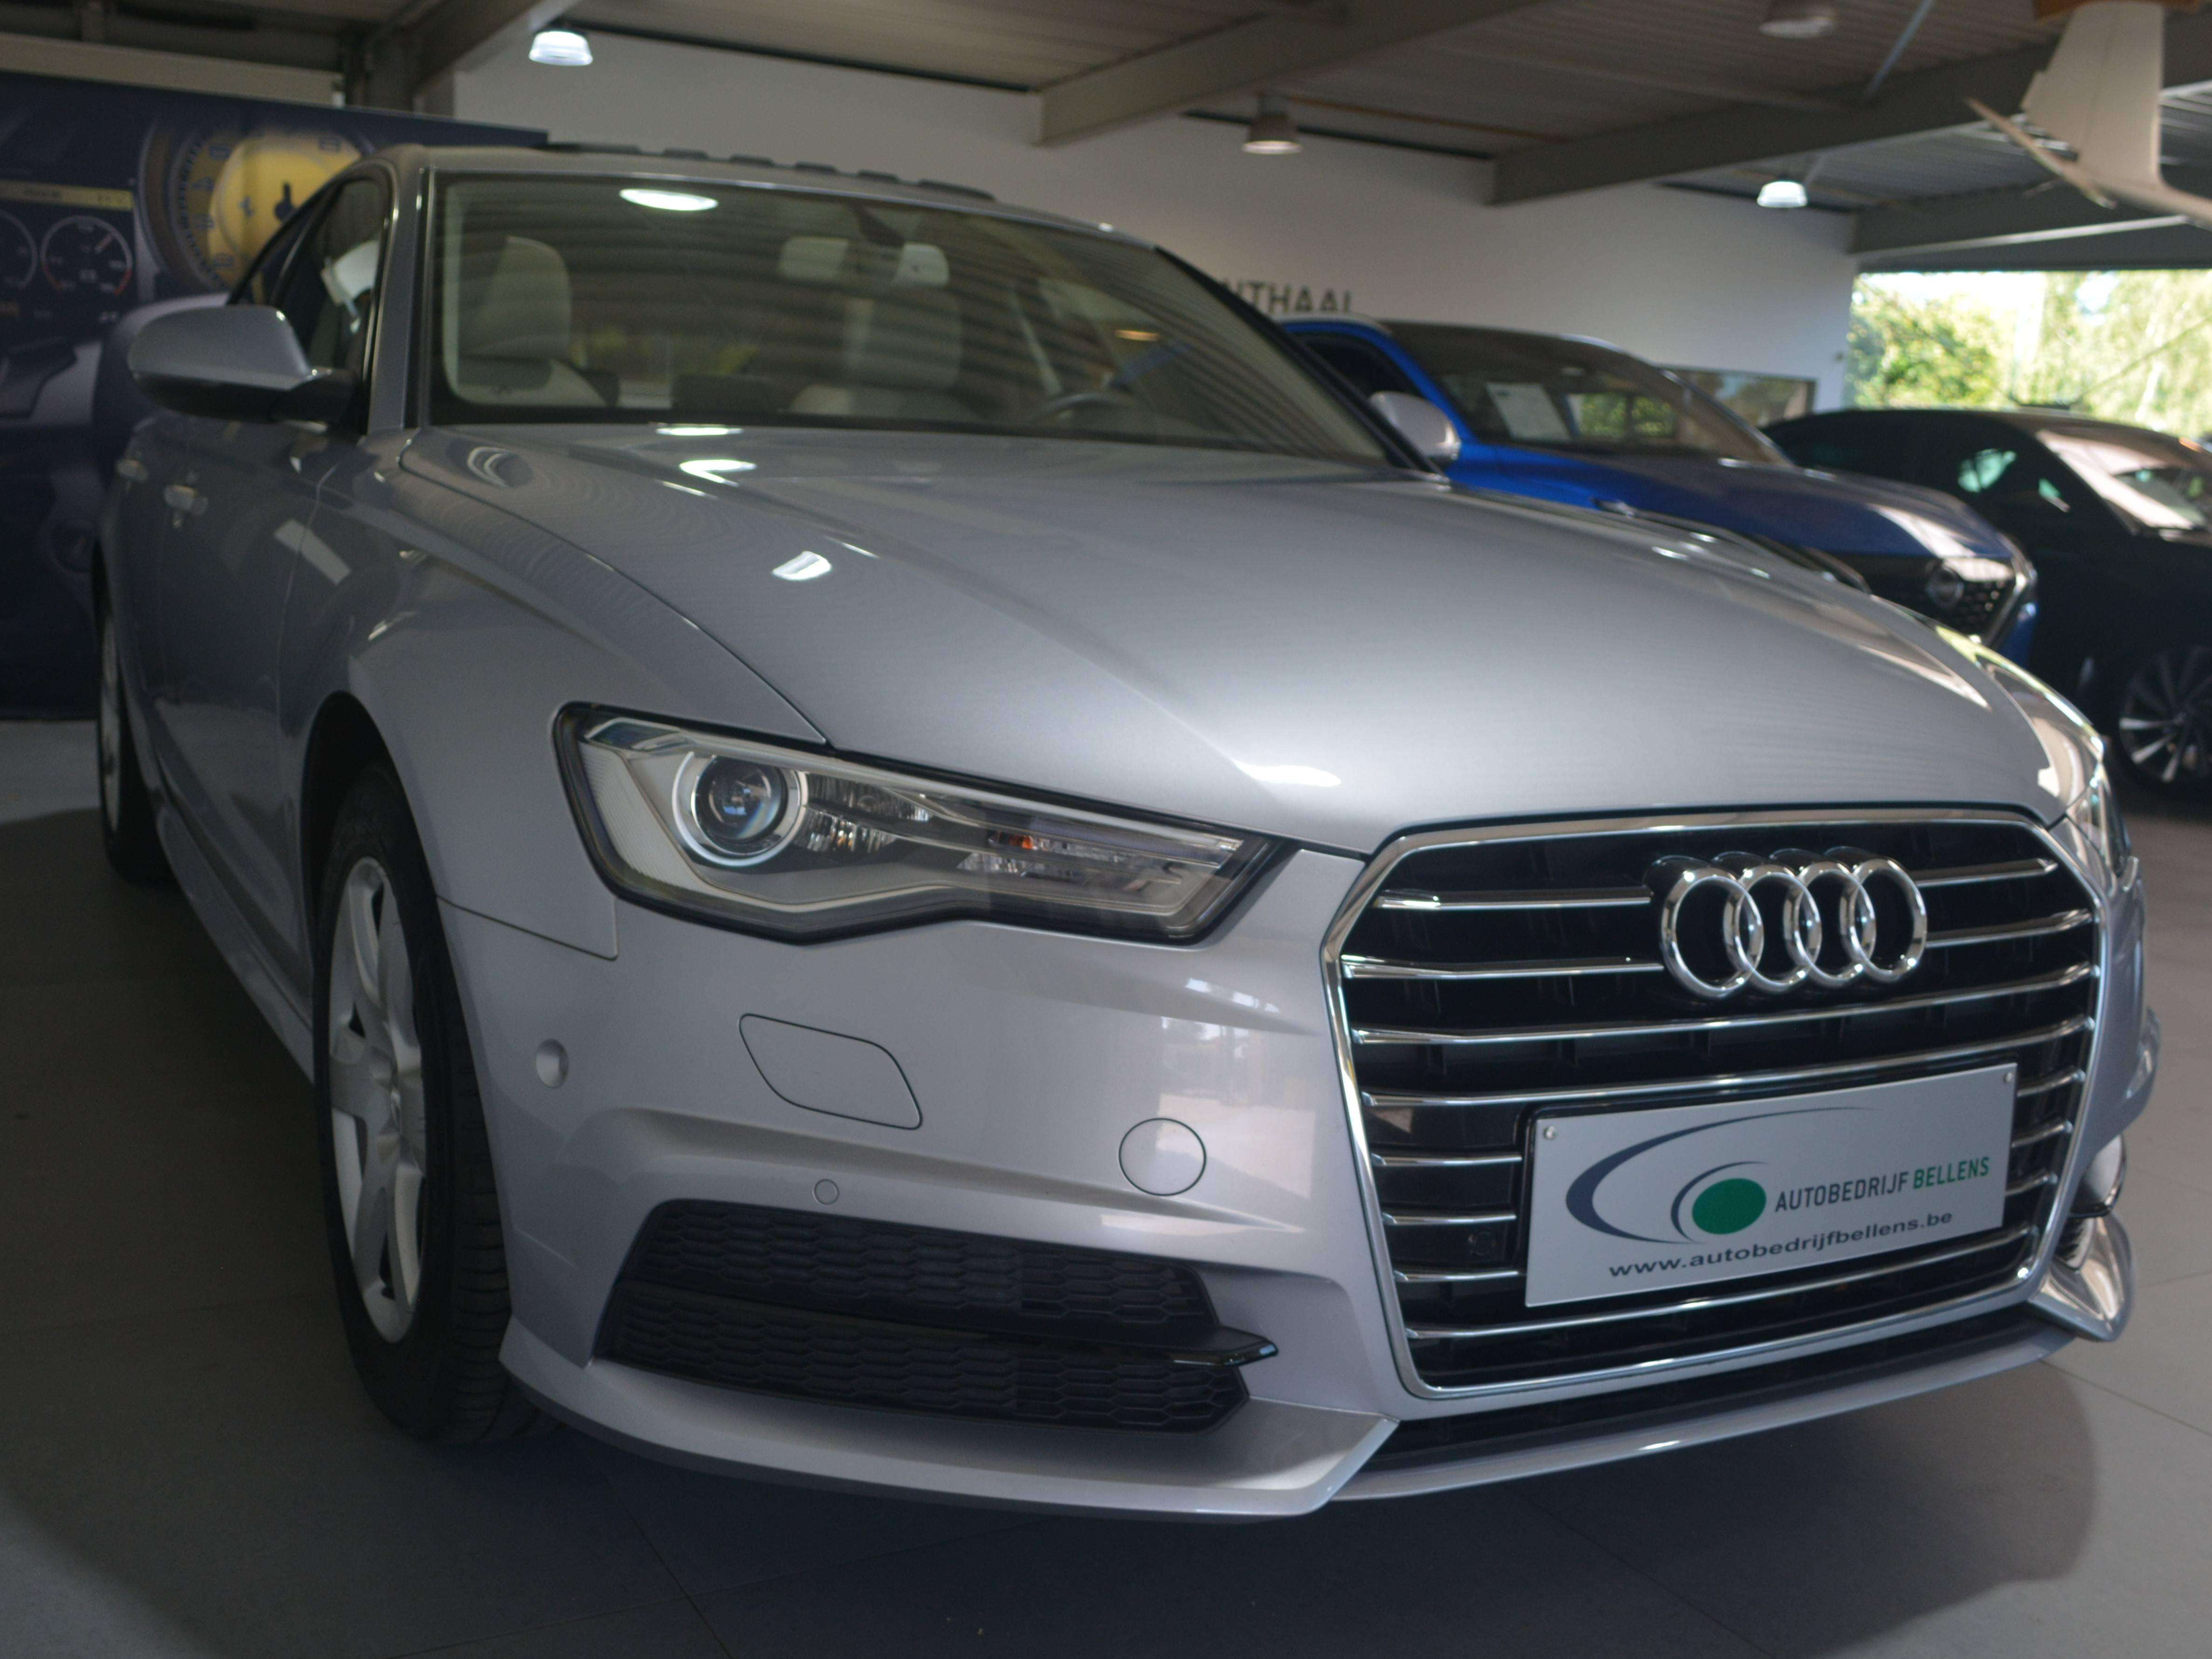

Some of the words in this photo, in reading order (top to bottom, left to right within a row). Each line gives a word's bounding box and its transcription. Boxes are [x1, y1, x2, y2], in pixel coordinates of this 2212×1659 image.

[1776, 1172, 1909, 1213] AUTOBEDRIJF
[1913, 1156, 1990, 1189] BELLENS
[1609, 1213, 1952, 1277] www.autobedrijfbellens.be
